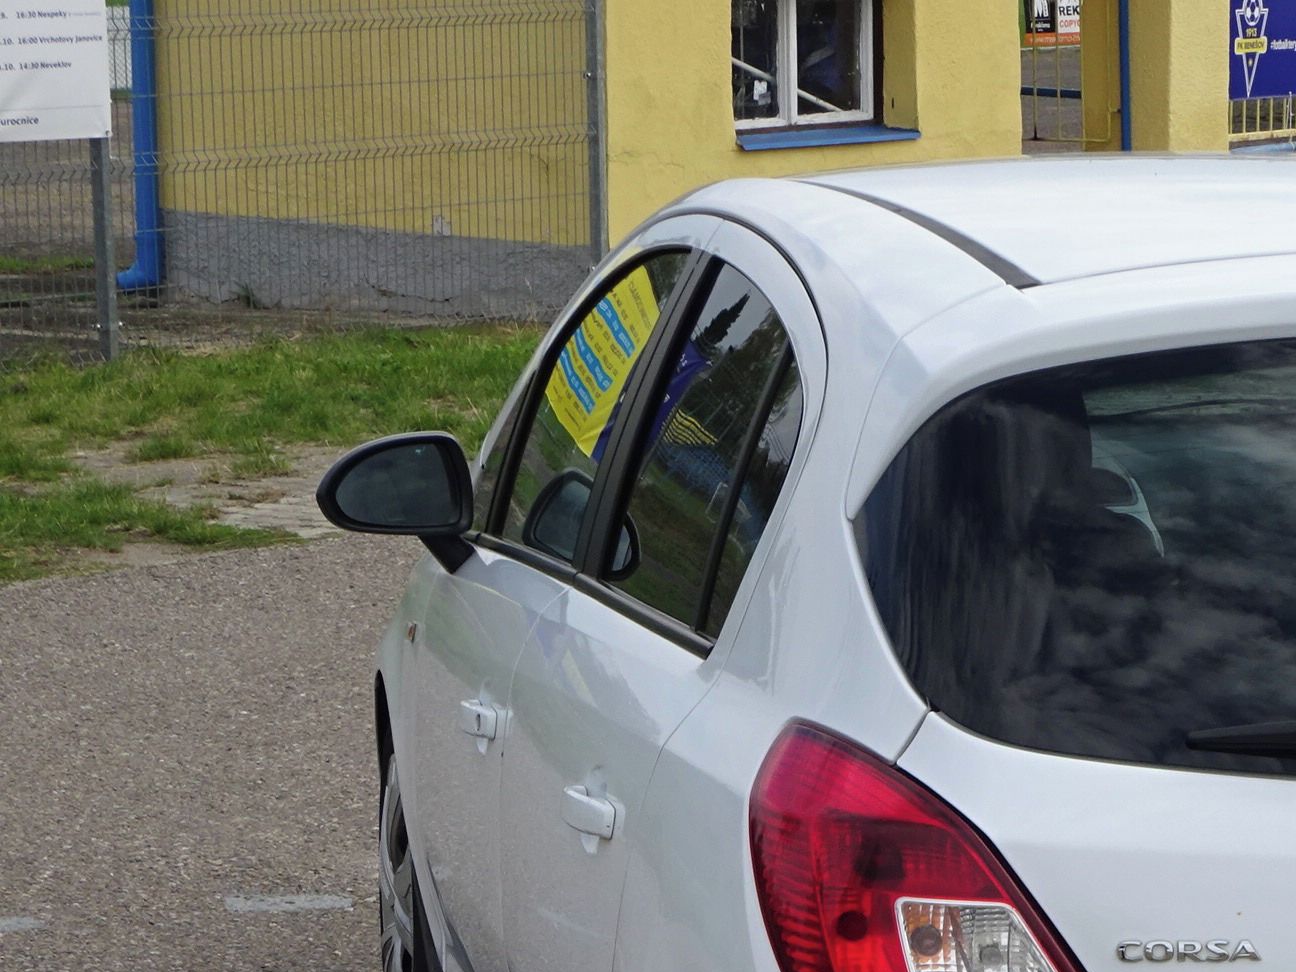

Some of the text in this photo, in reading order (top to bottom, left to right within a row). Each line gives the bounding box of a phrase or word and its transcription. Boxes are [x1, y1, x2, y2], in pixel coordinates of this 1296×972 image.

[16, 11, 36, 19] 16:30
[37, 11, 67, 19] Nespeky
[39, 35, 74, 44] Vrchotovy
[19, 62, 39, 70] 14:30
[40, 61, 72, 69] Neveklov
[1117, 939, 1262, 962] CORSA
